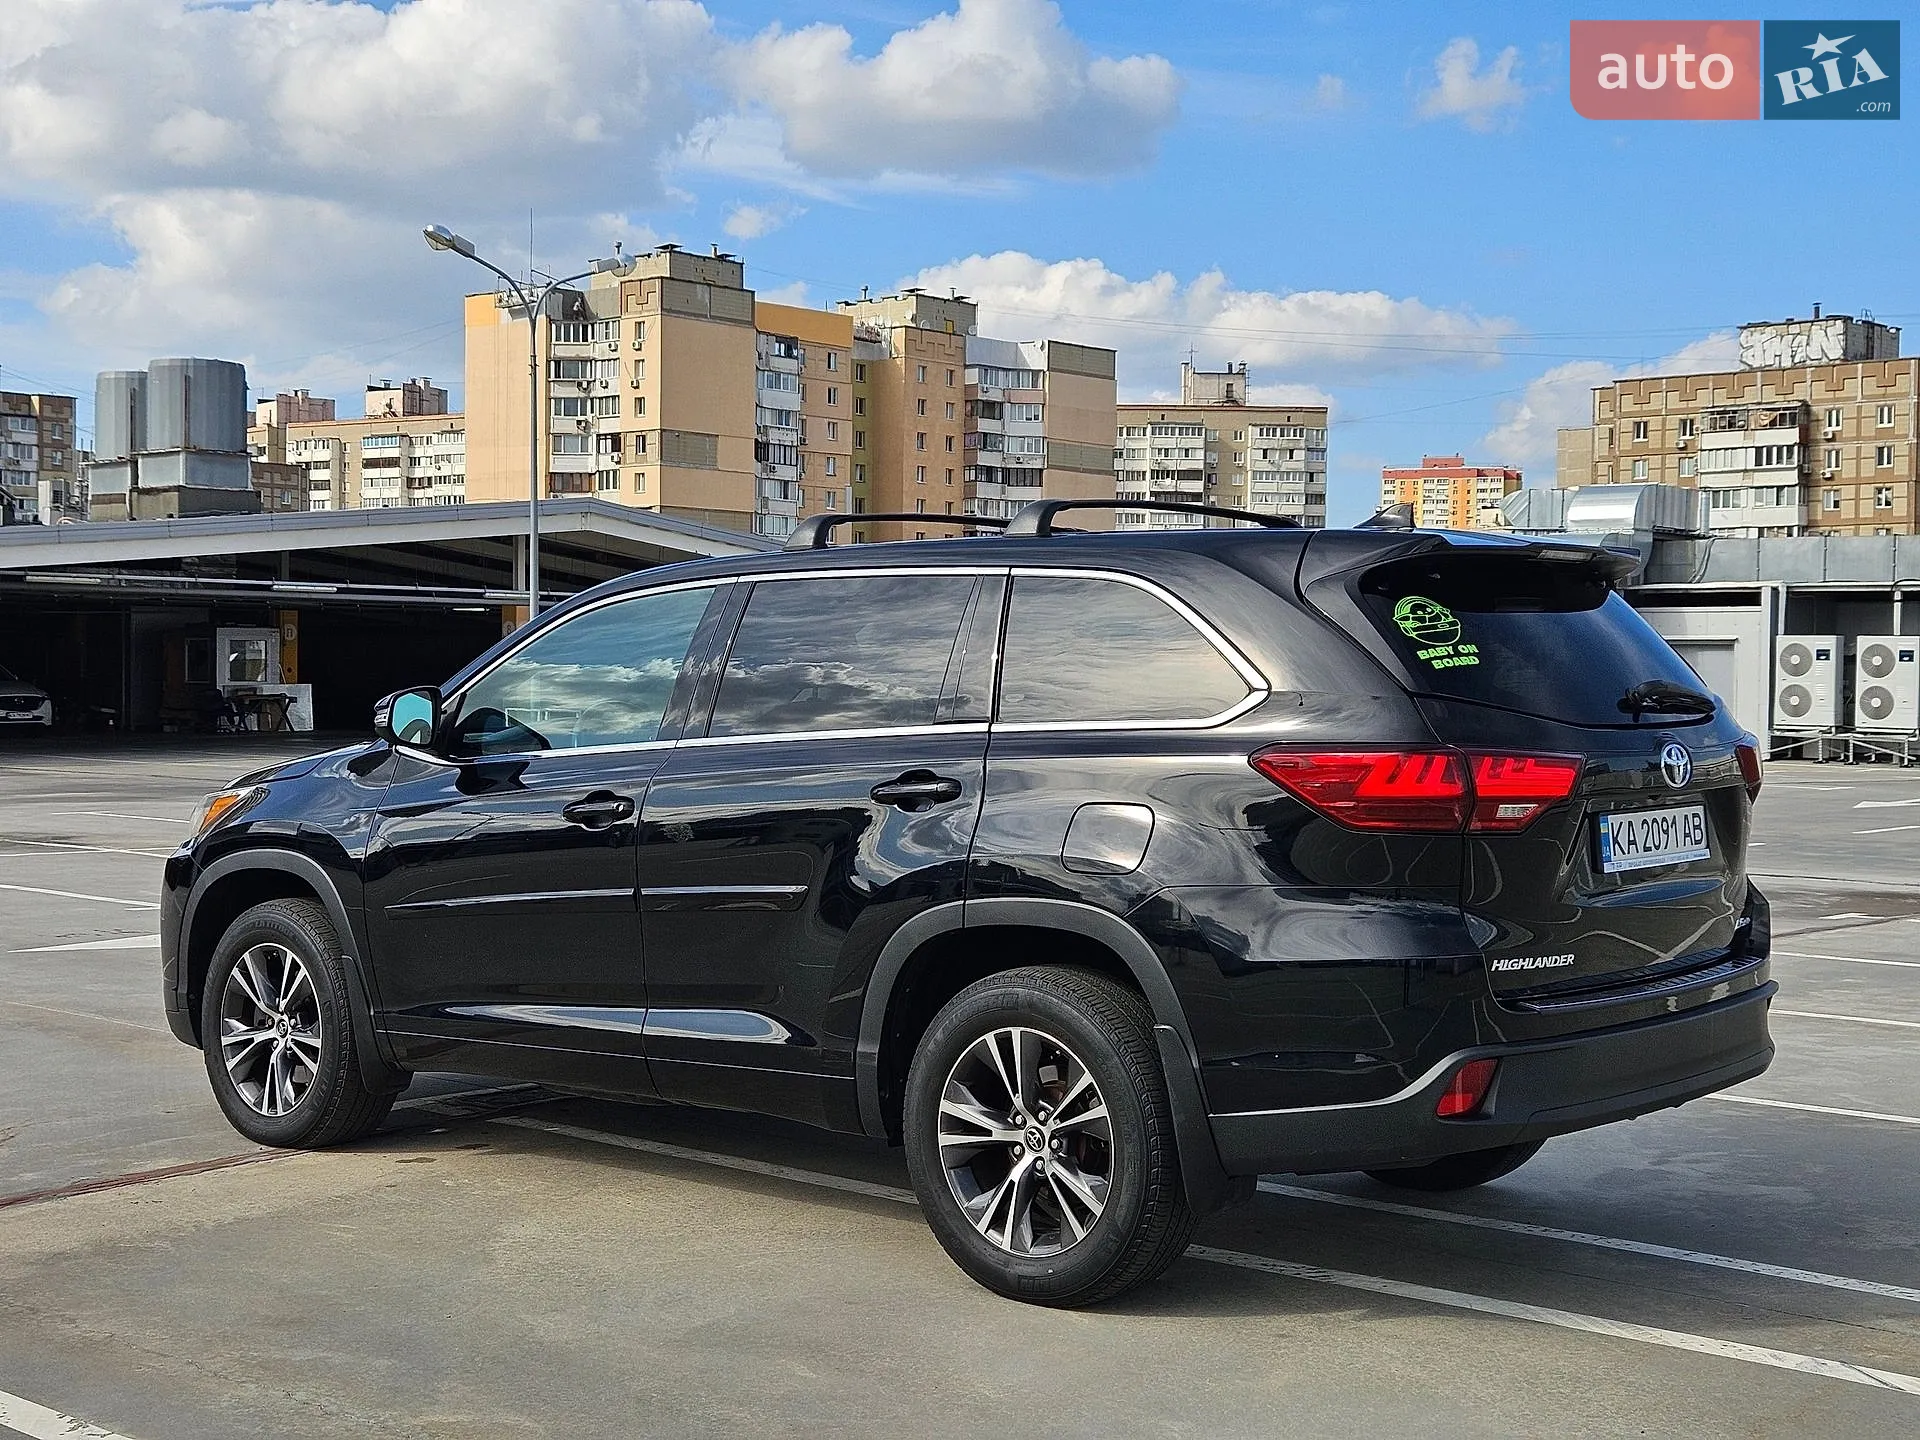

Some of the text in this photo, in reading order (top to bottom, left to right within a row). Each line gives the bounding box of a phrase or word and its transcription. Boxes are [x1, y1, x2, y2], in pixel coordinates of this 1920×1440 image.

[1417, 645, 1479, 660] BABY ON
[1431, 656, 1480, 669] BOARD
[1491, 954, 1575, 972] HIGHLANDER
